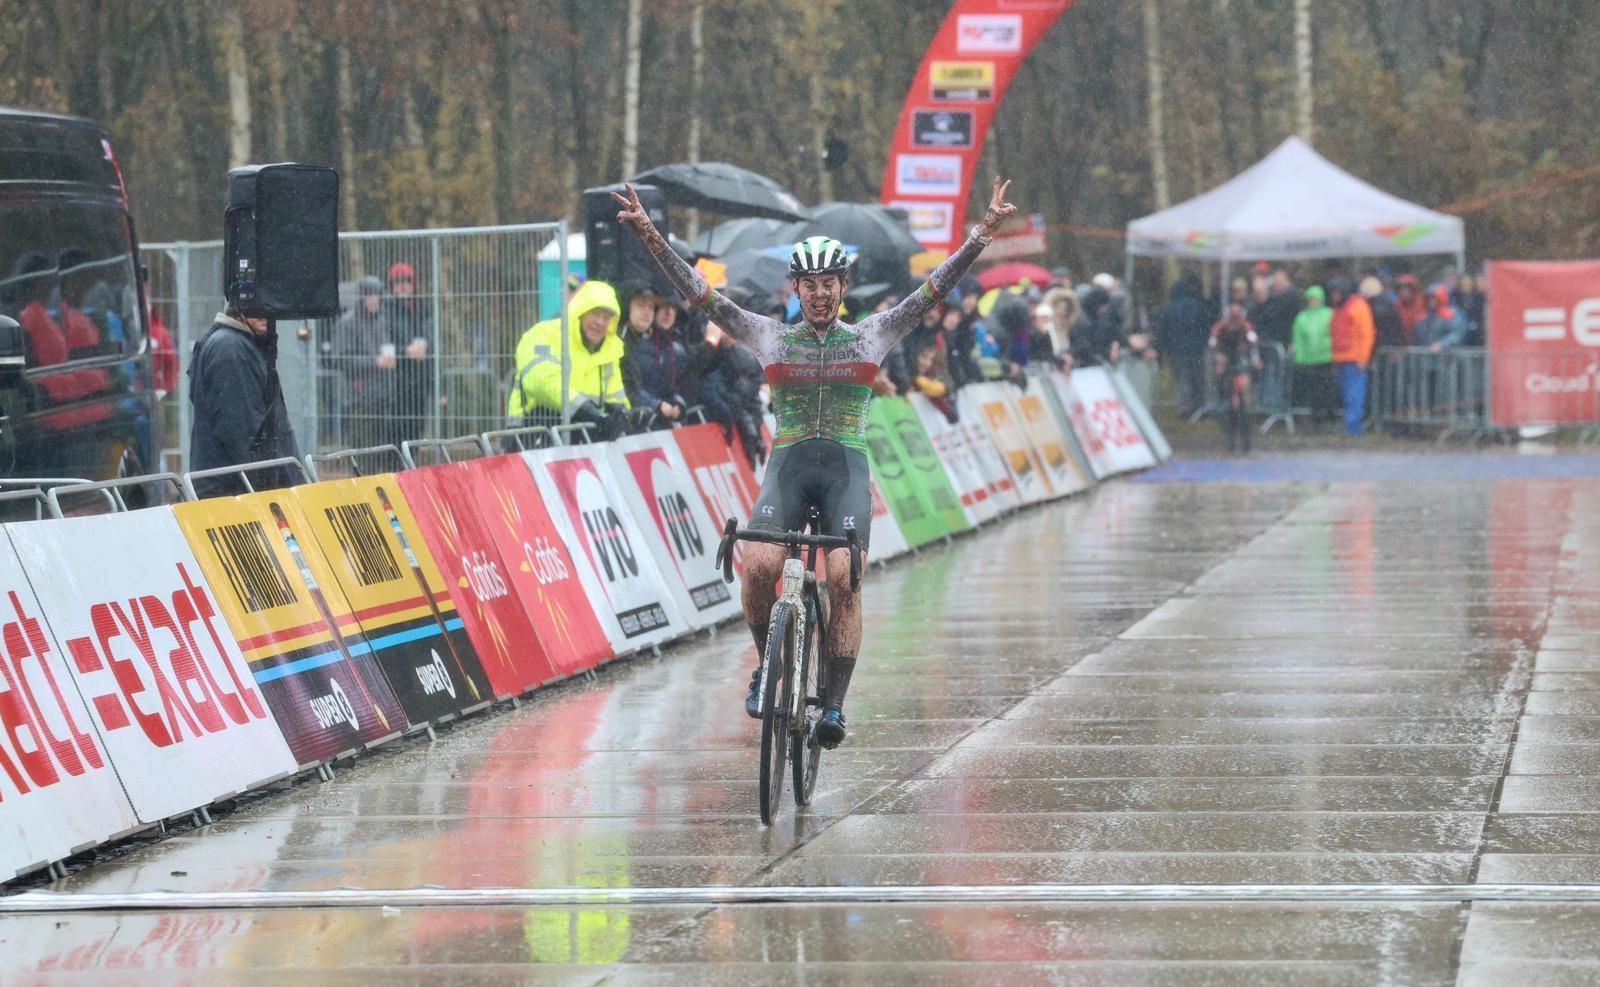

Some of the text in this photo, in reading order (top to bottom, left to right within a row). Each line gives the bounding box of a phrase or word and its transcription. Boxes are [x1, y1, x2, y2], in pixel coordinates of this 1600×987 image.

[206, 521, 299, 614] FLANDRIEN
[324, 503, 404, 588] FLANDRIEN
[523, 535, 570, 586] Cofidis
[461, 550, 509, 603] Cofidis
[415, 663, 446, 696] SUPER
[309, 694, 347, 729] SUPER
